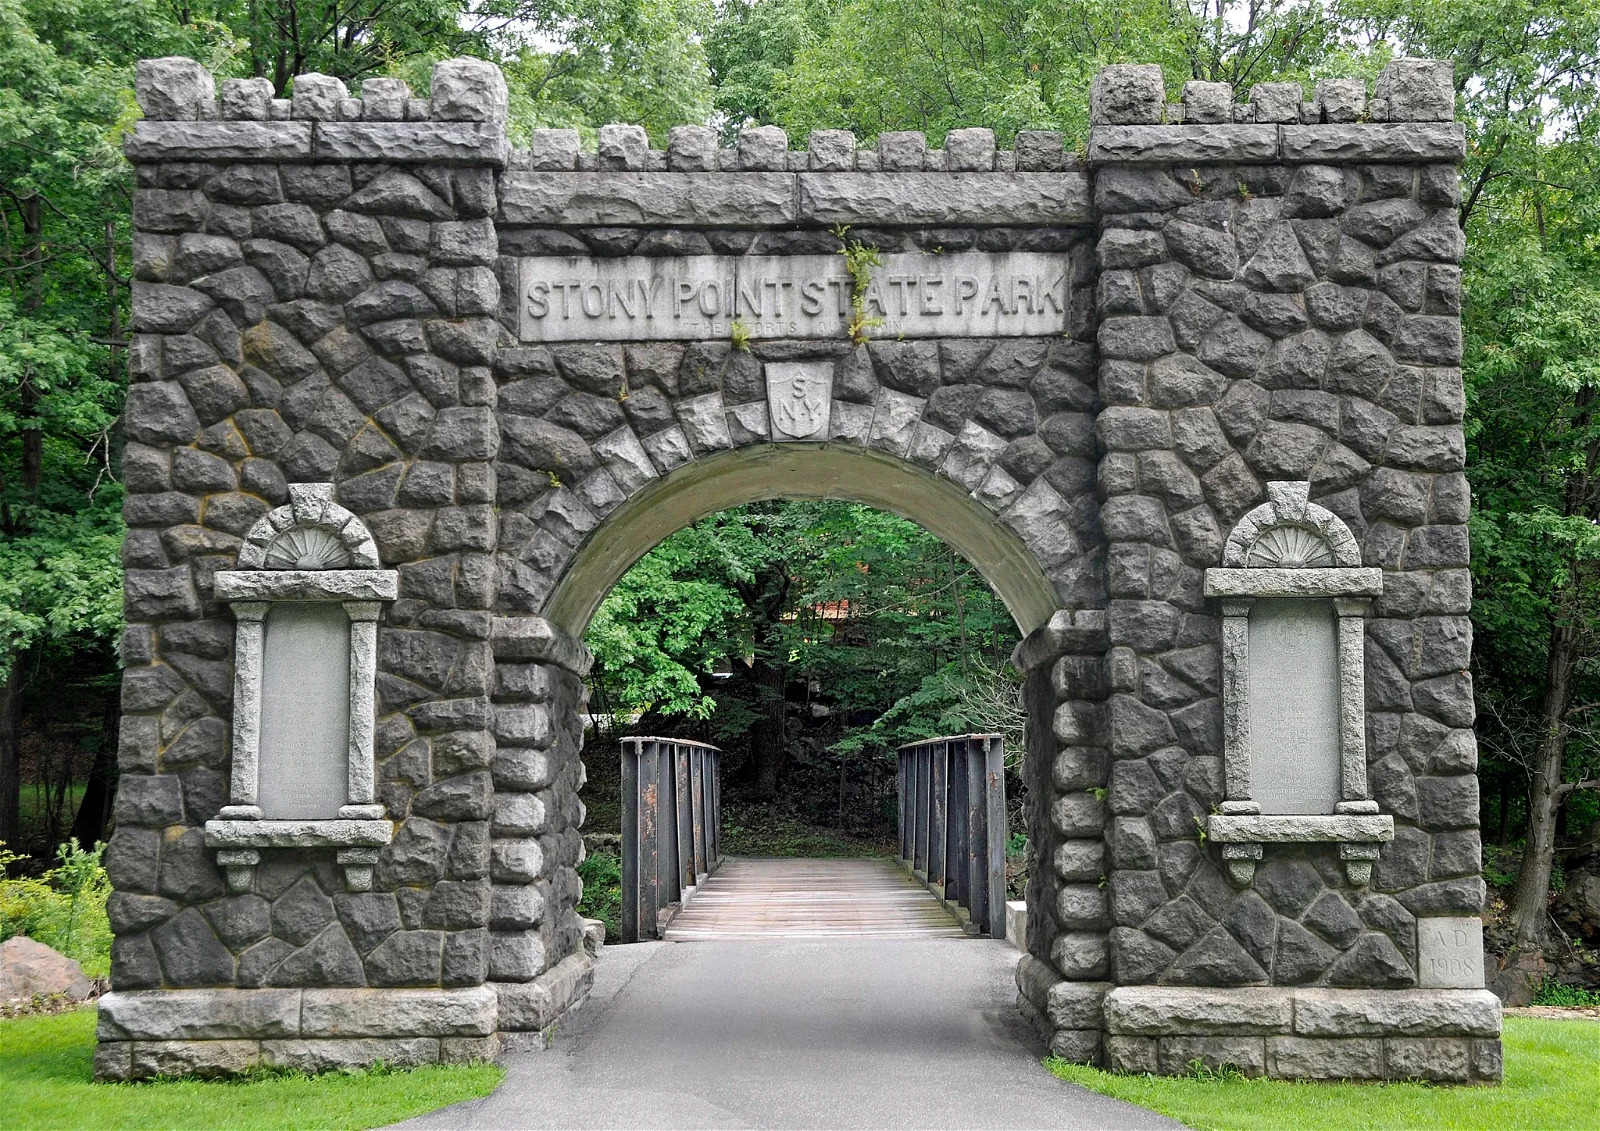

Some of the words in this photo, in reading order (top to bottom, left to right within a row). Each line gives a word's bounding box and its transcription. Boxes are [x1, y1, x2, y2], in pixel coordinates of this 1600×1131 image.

[527, 277, 663, 320] STONY
[673, 277, 793, 319] POINT
[800, 274, 944, 317] STATE
[954, 273, 1066, 316] PARK
[792, 375, 807, 399] S
[1430, 957, 1474, 977] 1908
